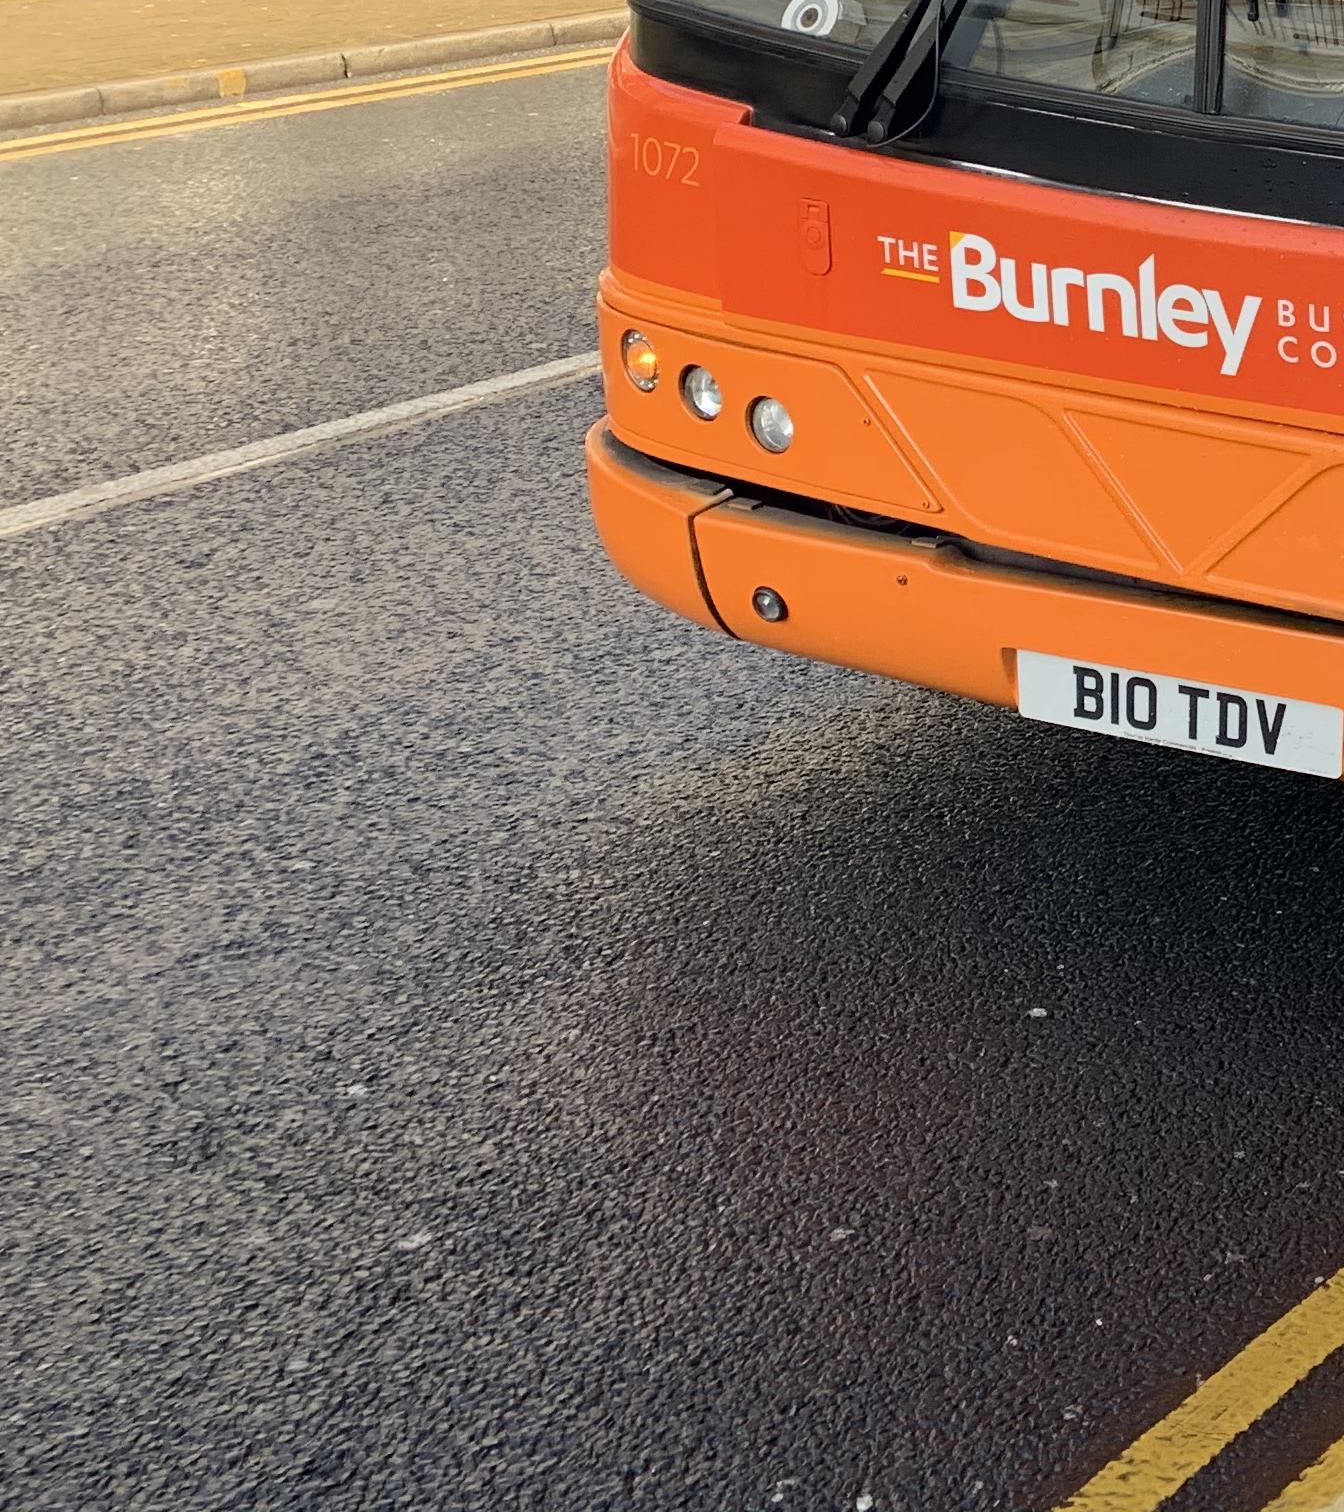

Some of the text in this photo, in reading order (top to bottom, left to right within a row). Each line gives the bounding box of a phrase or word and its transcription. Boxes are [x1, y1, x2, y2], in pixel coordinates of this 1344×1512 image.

[631, 132, 700, 187] 1072
[877, 231, 1262, 377] THE Burnley
[1178, 685, 1287, 756] TDV
